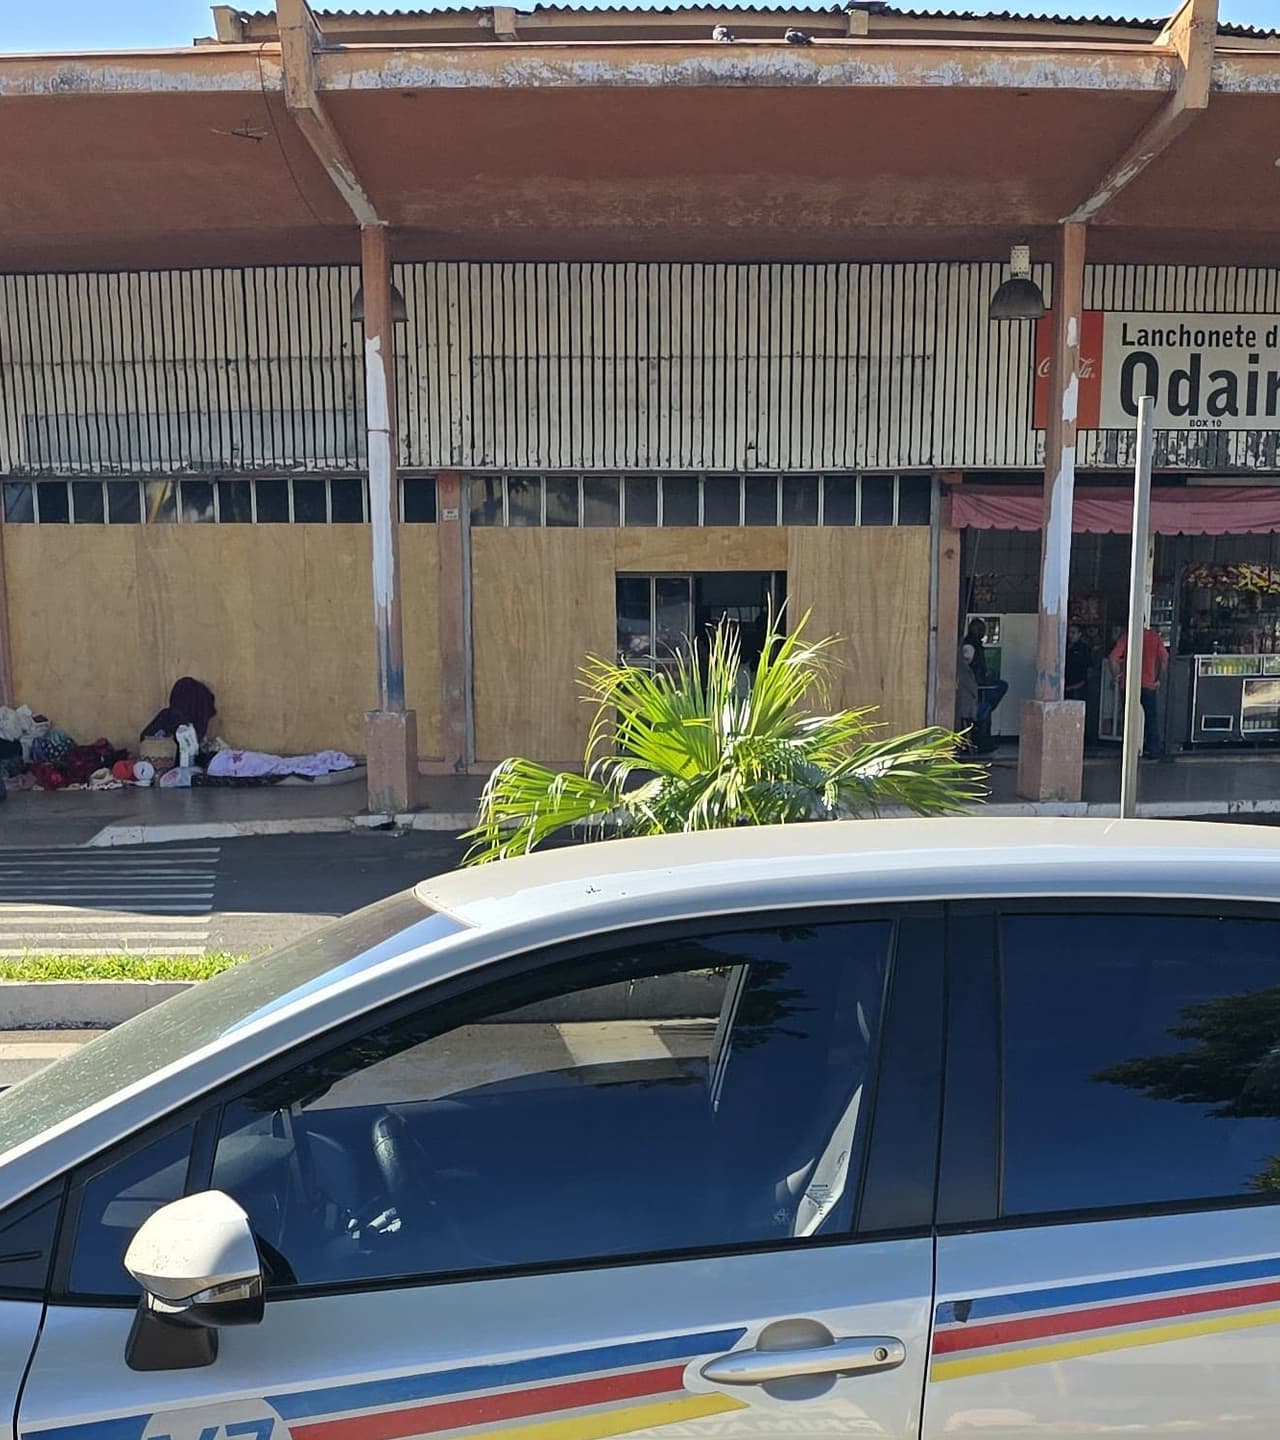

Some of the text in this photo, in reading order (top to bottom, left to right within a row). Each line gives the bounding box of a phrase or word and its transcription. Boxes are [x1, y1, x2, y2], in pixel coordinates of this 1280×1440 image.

[1122, 323, 1256, 348] Lanchonete
[1189, 419, 1222, 428] BOX 10
